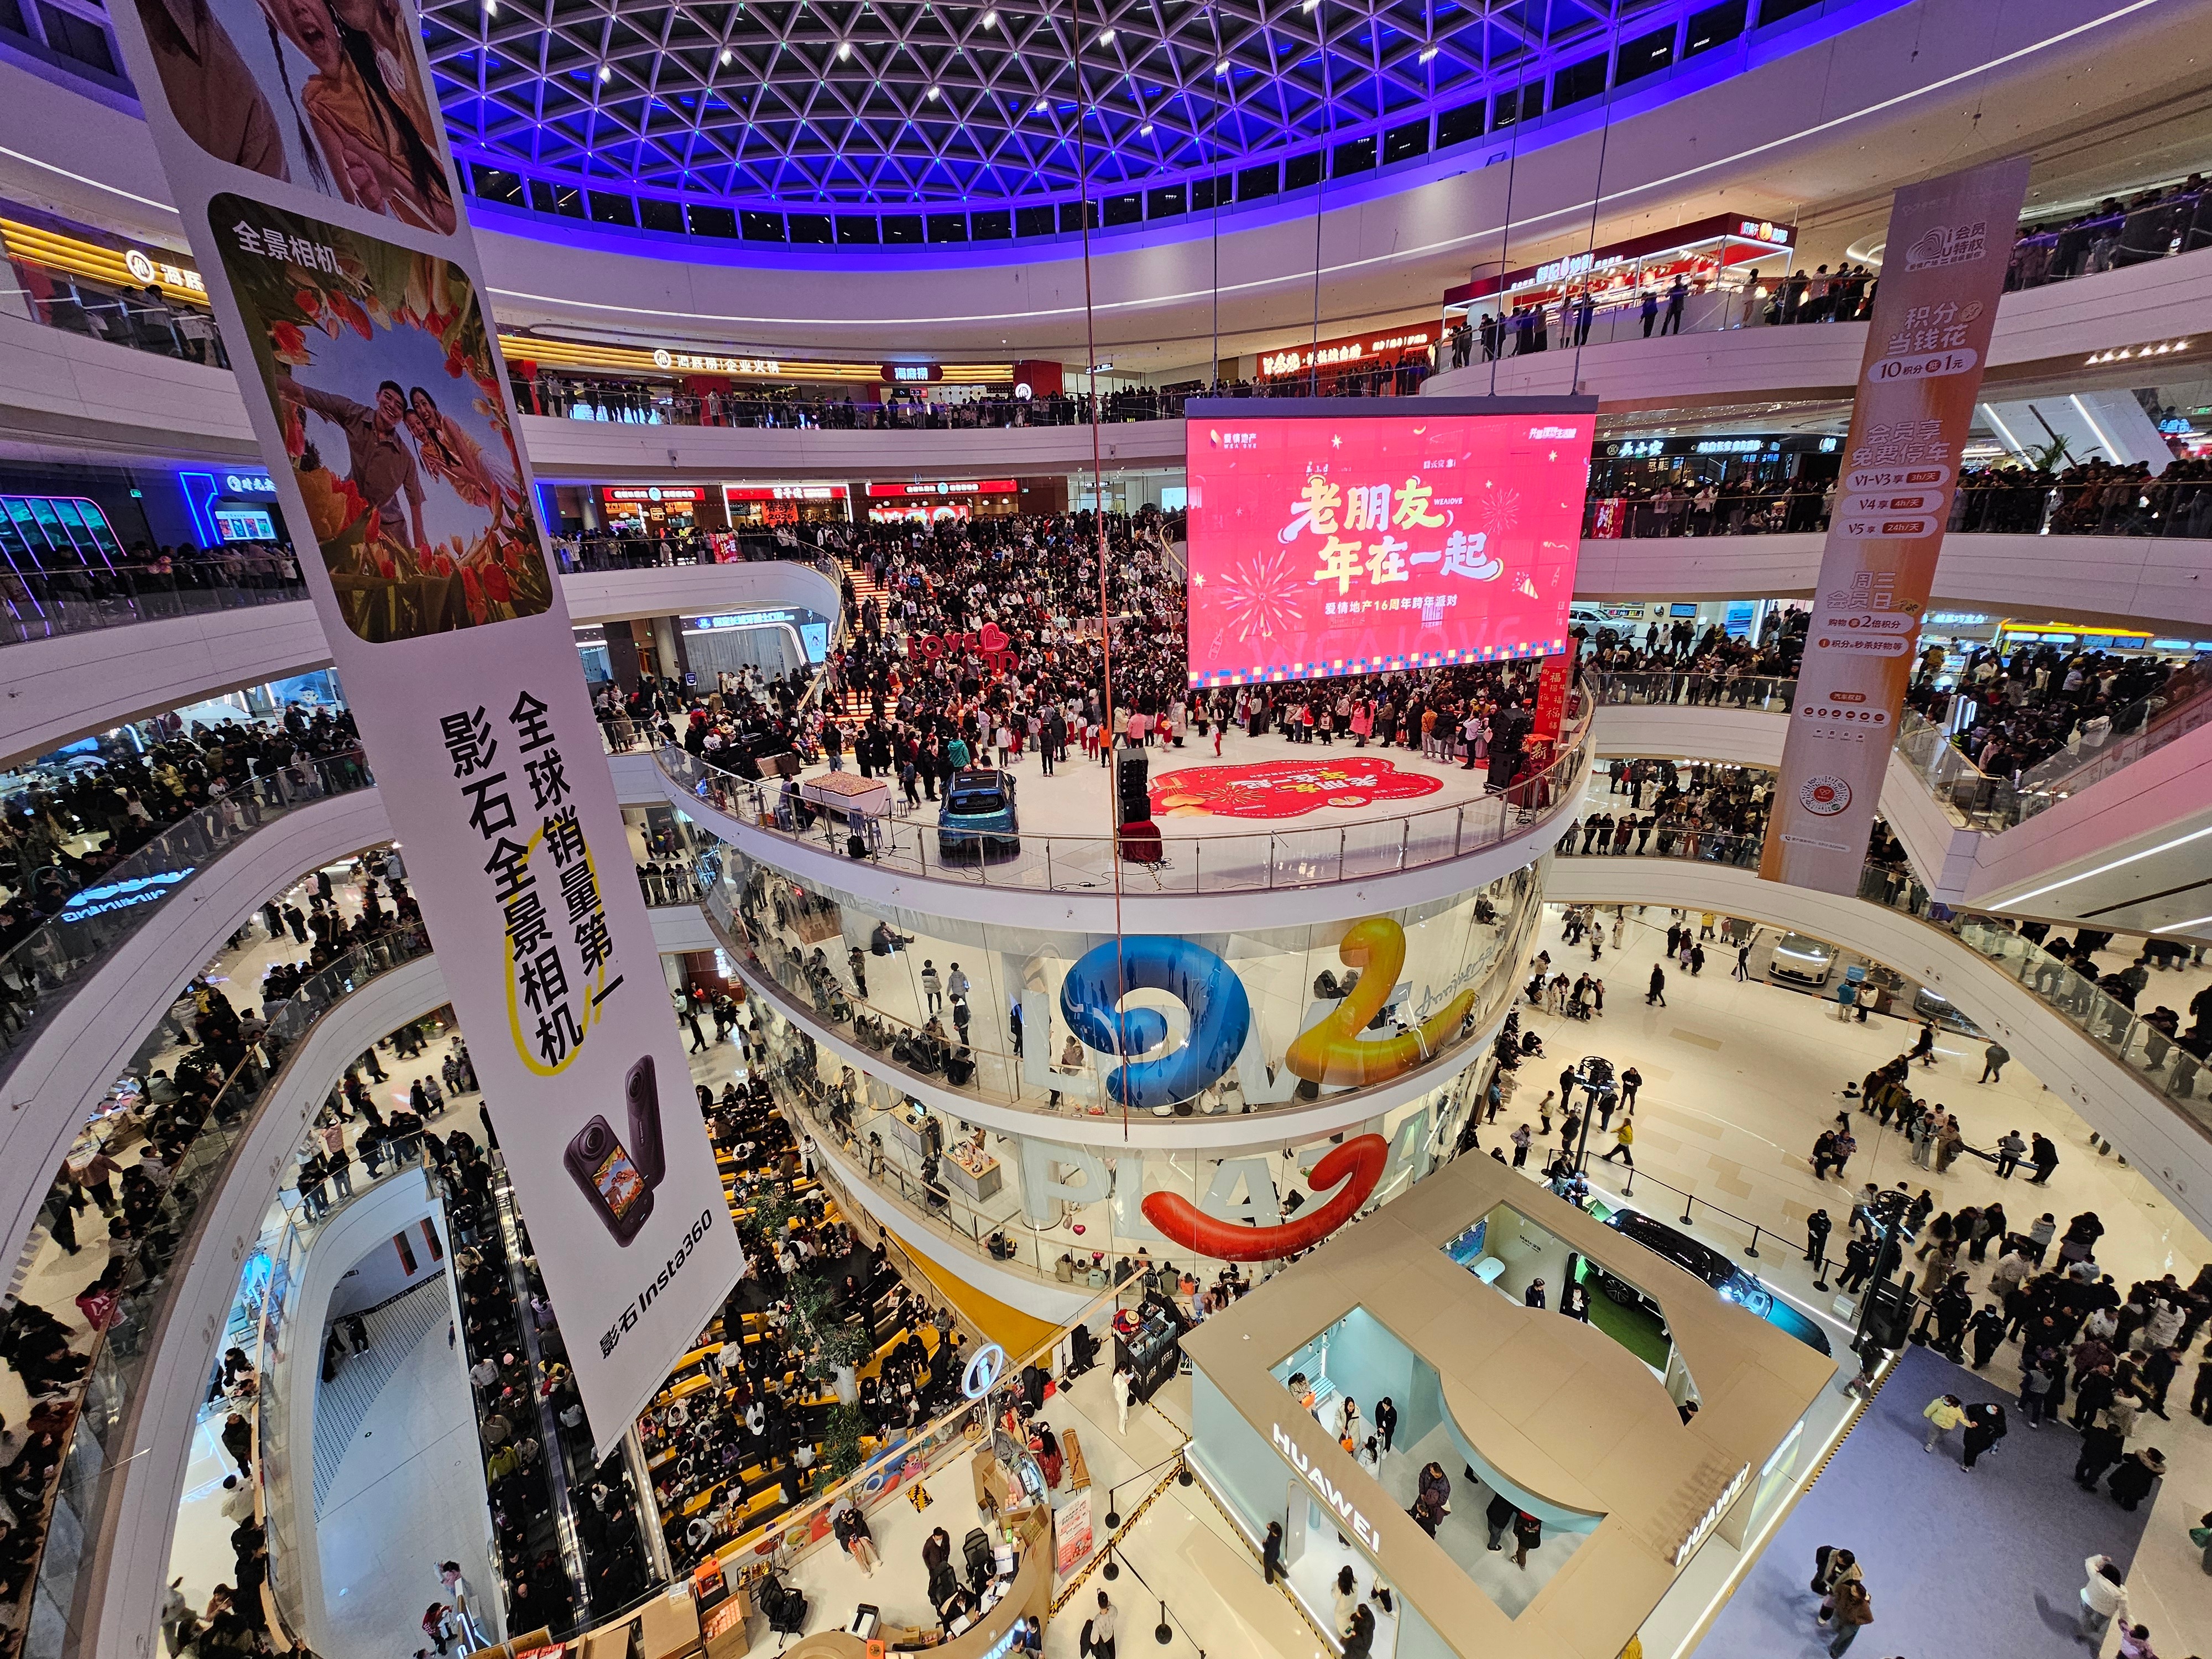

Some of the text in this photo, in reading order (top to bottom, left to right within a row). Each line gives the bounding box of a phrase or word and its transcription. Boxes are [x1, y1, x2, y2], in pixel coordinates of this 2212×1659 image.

[233, 220, 343, 275] 全景相机
[1904, 301, 1959, 330] 积分
[1886, 323, 1969, 356] 当钱花
[894, 367, 928, 380] 海底捞
[1867, 419, 1943, 445] 会员享
[1850, 441, 1951, 467] 免费停车
[1282, 477, 1446, 542] 老朋友
[1887, 523, 1919, 531] 24h/天
[1313, 529, 1501, 597] 年在一起
[1850, 571, 1896, 589] 周三
[1324, 594, 1458, 615] 爱情地产16周年跨年派对
[1827, 590, 1893, 609] 会员日
[1827, 615, 1901, 629] 购物2倍积分
[906, 632, 978, 660] LOVE
[1550, 672, 1561, 683] 福
[1530, 742, 1548, 760] 新
[509, 690, 624, 1008] 全球销量第一
[439, 705, 585, 1068] 影石全景相机
[599, 1208, 713, 1360] 影石 Insta360
[1272, 1422, 1381, 1554] HUAWEI
[1675, 1460, 1751, 1568] HUAWEI
